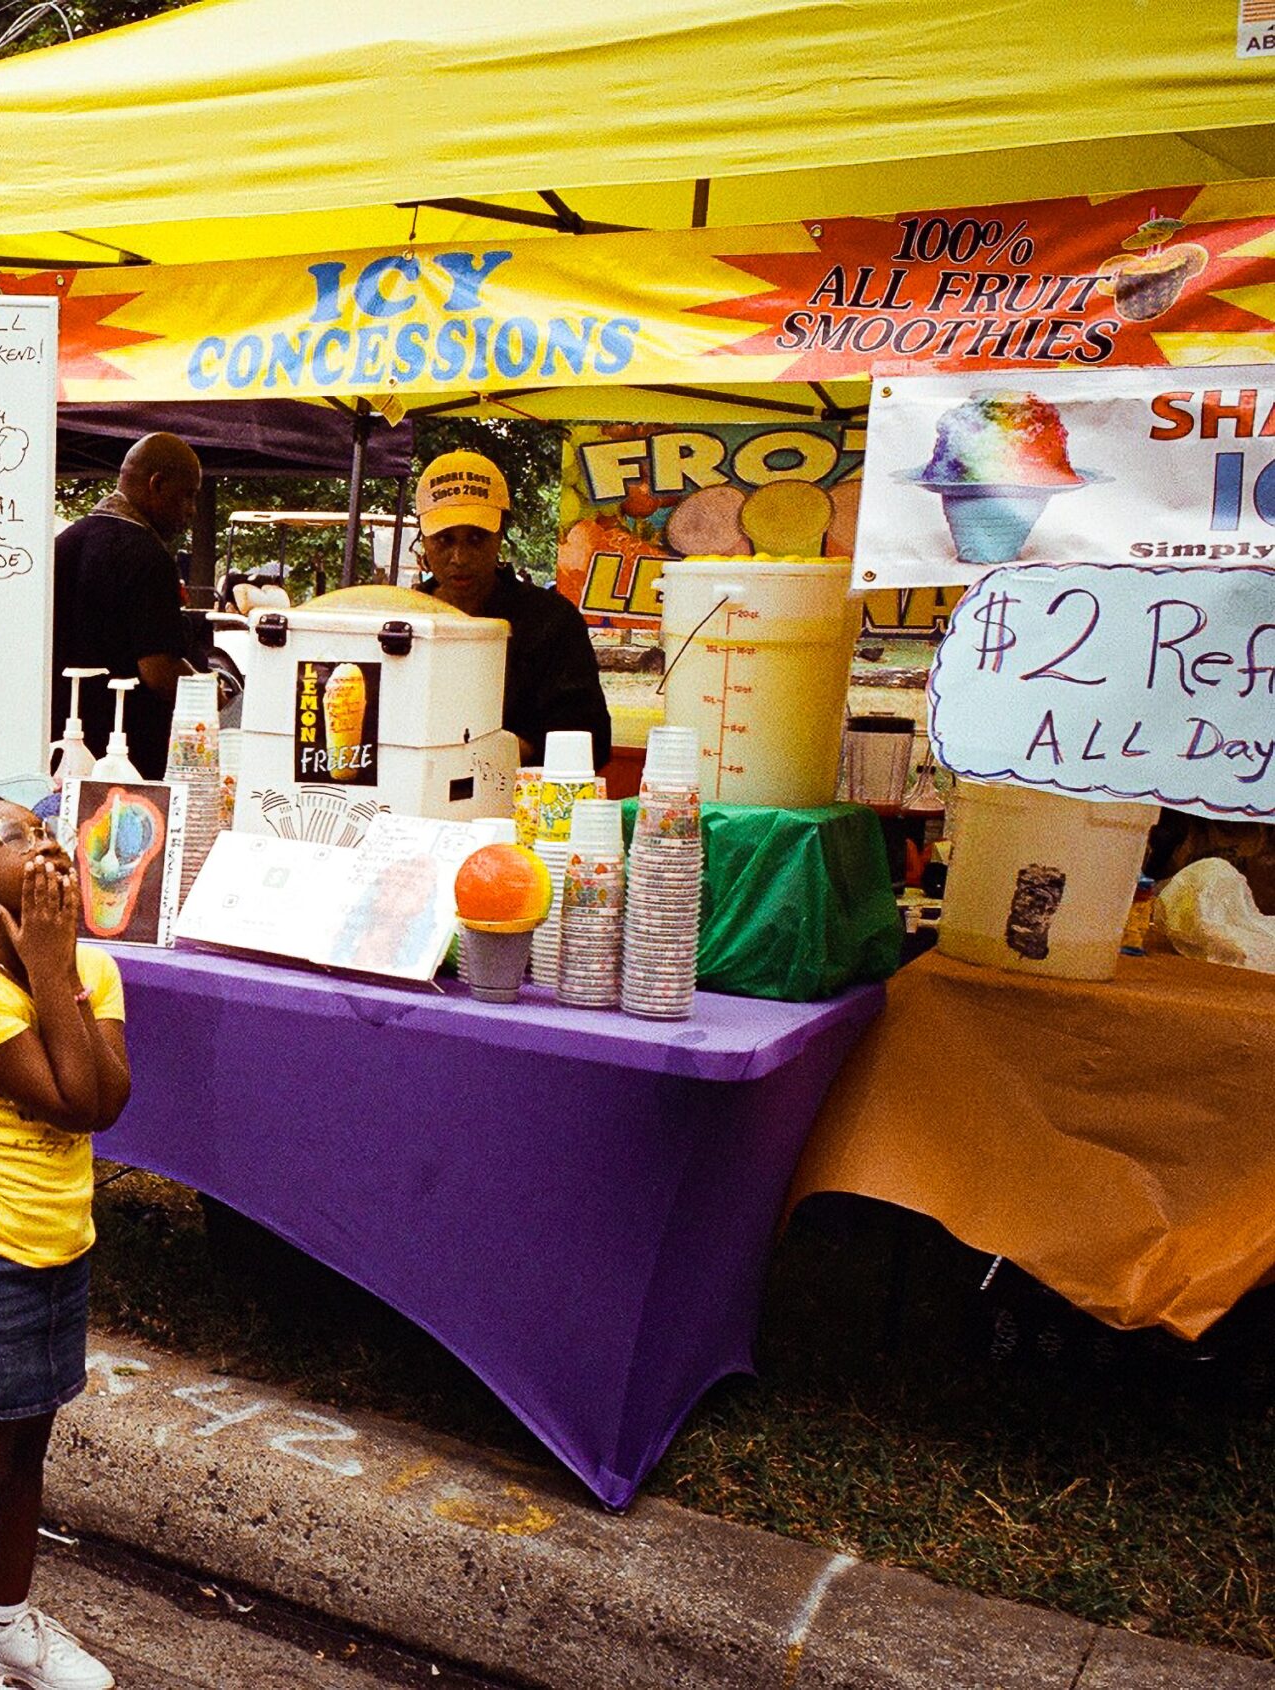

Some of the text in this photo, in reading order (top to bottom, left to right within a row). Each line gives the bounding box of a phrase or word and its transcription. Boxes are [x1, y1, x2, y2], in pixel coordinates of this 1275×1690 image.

[891, 216, 1035, 267] 100%
[306, 250, 513, 323] ICY
[808, 264, 1116, 317] ALL FRUIT
[186, 316, 641, 391] CONCESSIONS
[775, 310, 1121, 365] SMOOTHIES
[1129, 542, 1275, 560] Simply
[973, 588, 1107, 686] $2
[300, 662, 319, 743] LEMON
[301, 743, 373, 774] FREEZE
[1025, 709, 1275, 784] ALL Day
